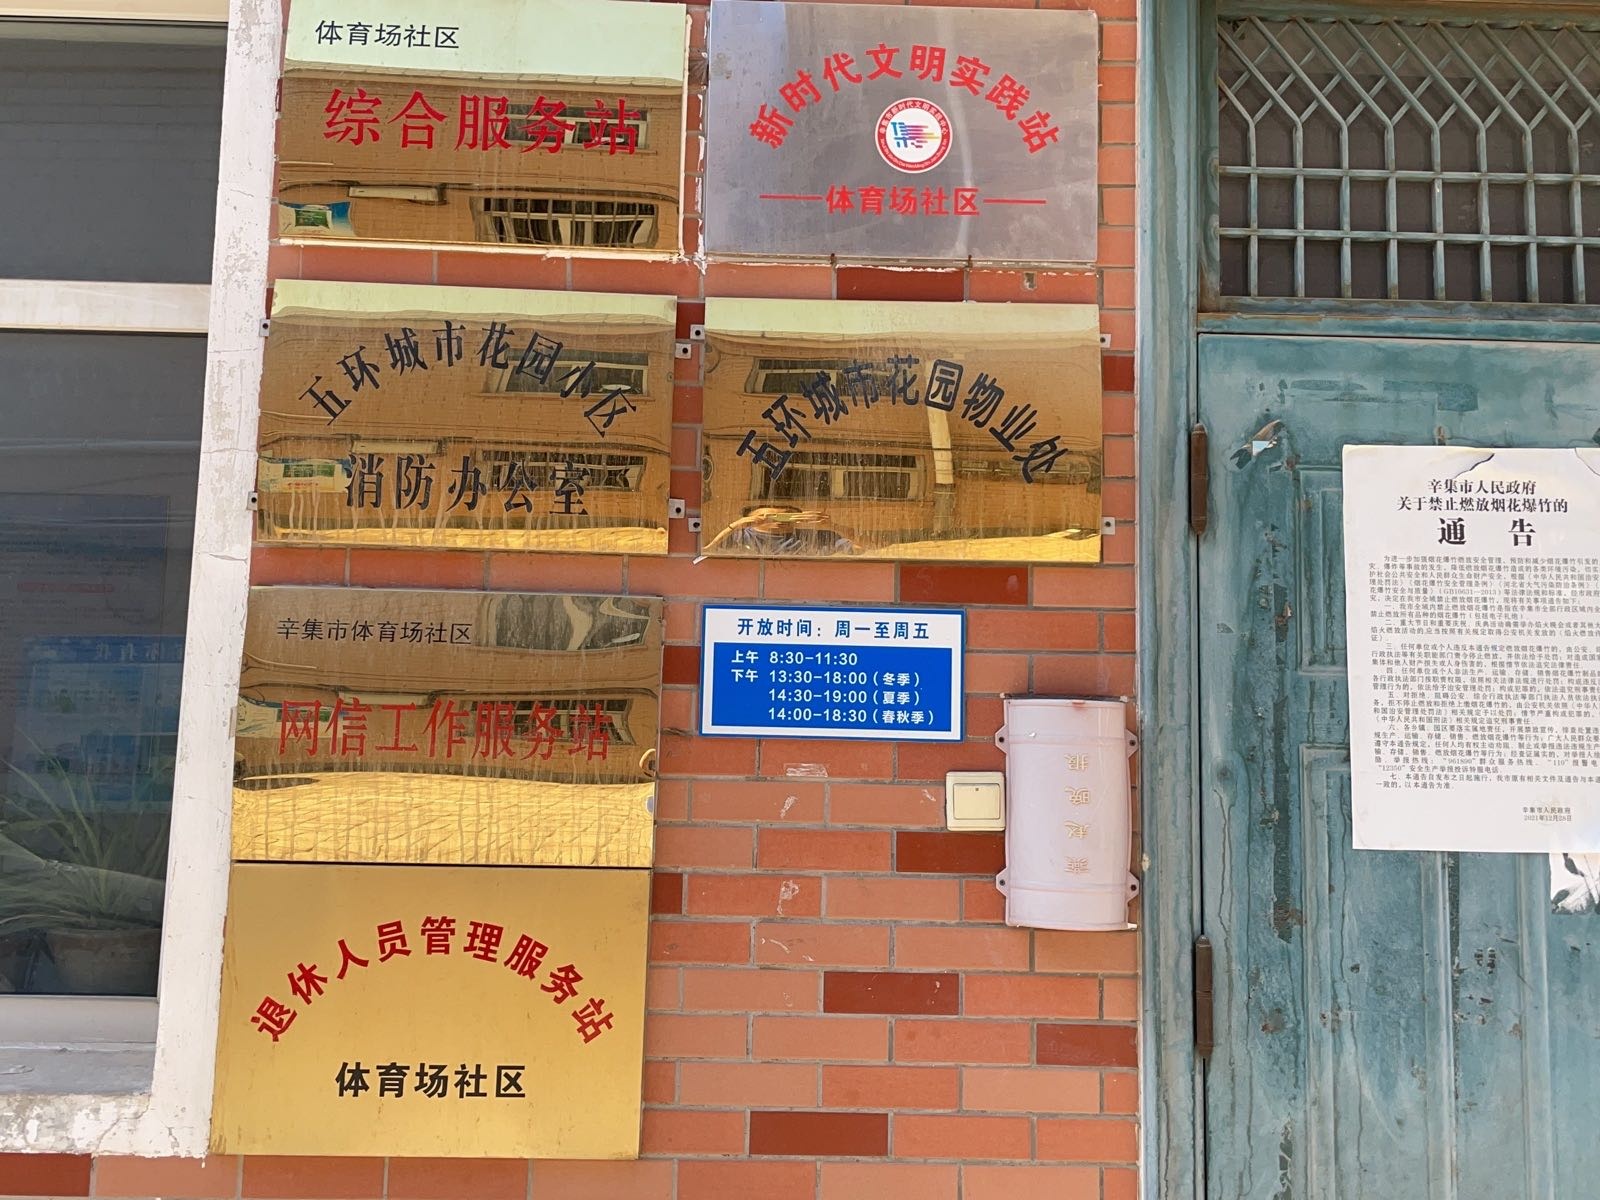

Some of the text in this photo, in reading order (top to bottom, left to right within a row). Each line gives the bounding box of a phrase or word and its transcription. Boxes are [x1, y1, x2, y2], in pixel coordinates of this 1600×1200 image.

[315, 20, 460, 49] 体育场社区
[748, 43, 1064, 155] 新时代文明实践站
[324, 88, 641, 156] 综合服务站
[826, 185, 980, 217] 体育场社区
[298, 320, 637, 437] 五环城市花园小区
[736, 353, 1069, 484] 五环城市花园物业处
[345, 452, 592, 516] 消防办公室
[1428, 478, 1537, 495] 辛集市人民政府
[1397, 496, 1569, 514] 关于禁止燃放烟花爆竹的
[276, 617, 473, 646] 辛集市体育场社区
[731, 650, 859, 666] 上午 8:30-11:30
[731, 669, 759, 683] 下午
[278, 697, 611, 762] 网信工作服务站
[249, 915, 616, 1044] 退休人员管理服务站
[335, 1062, 527, 1099] 体育场社区
